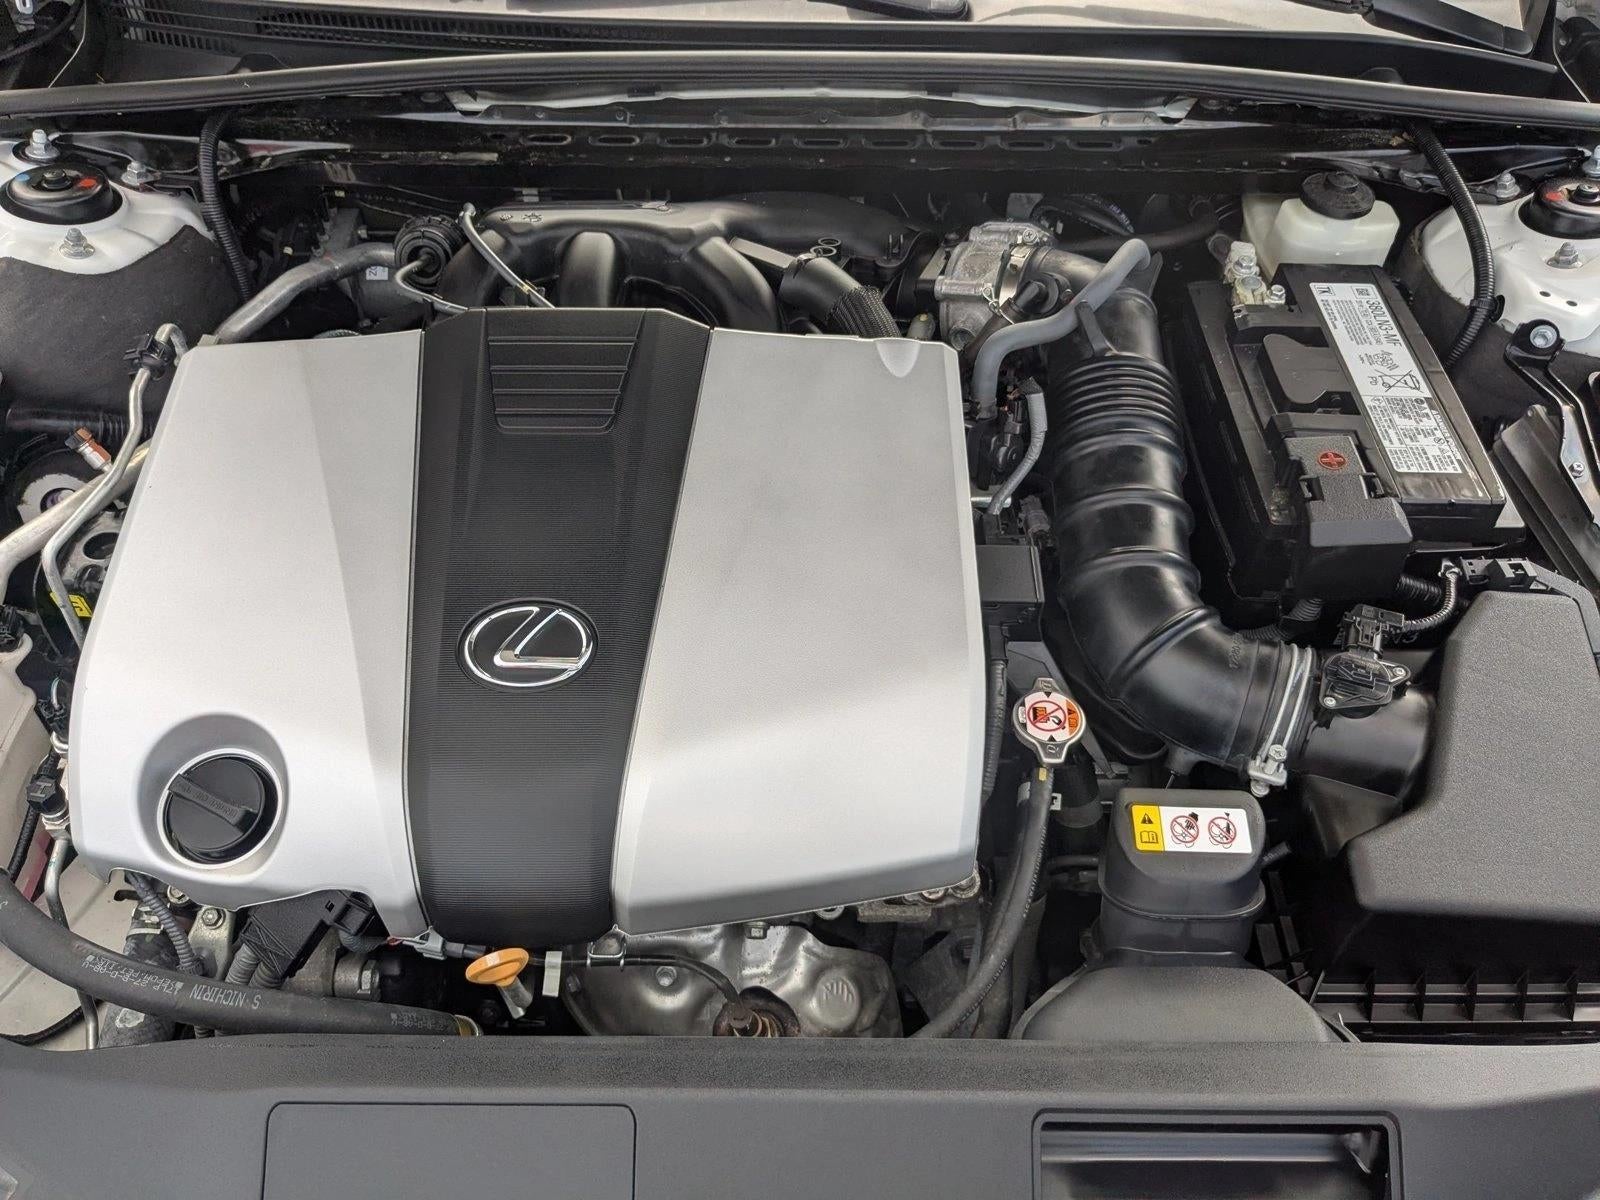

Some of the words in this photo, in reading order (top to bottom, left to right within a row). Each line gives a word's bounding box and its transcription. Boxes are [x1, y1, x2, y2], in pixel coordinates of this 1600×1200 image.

[1366, 300, 1402, 347] 380LN3-MF
[1367, 376, 1378, 386] Pb
[189, 983, 246, 1008] NICHIRIN
